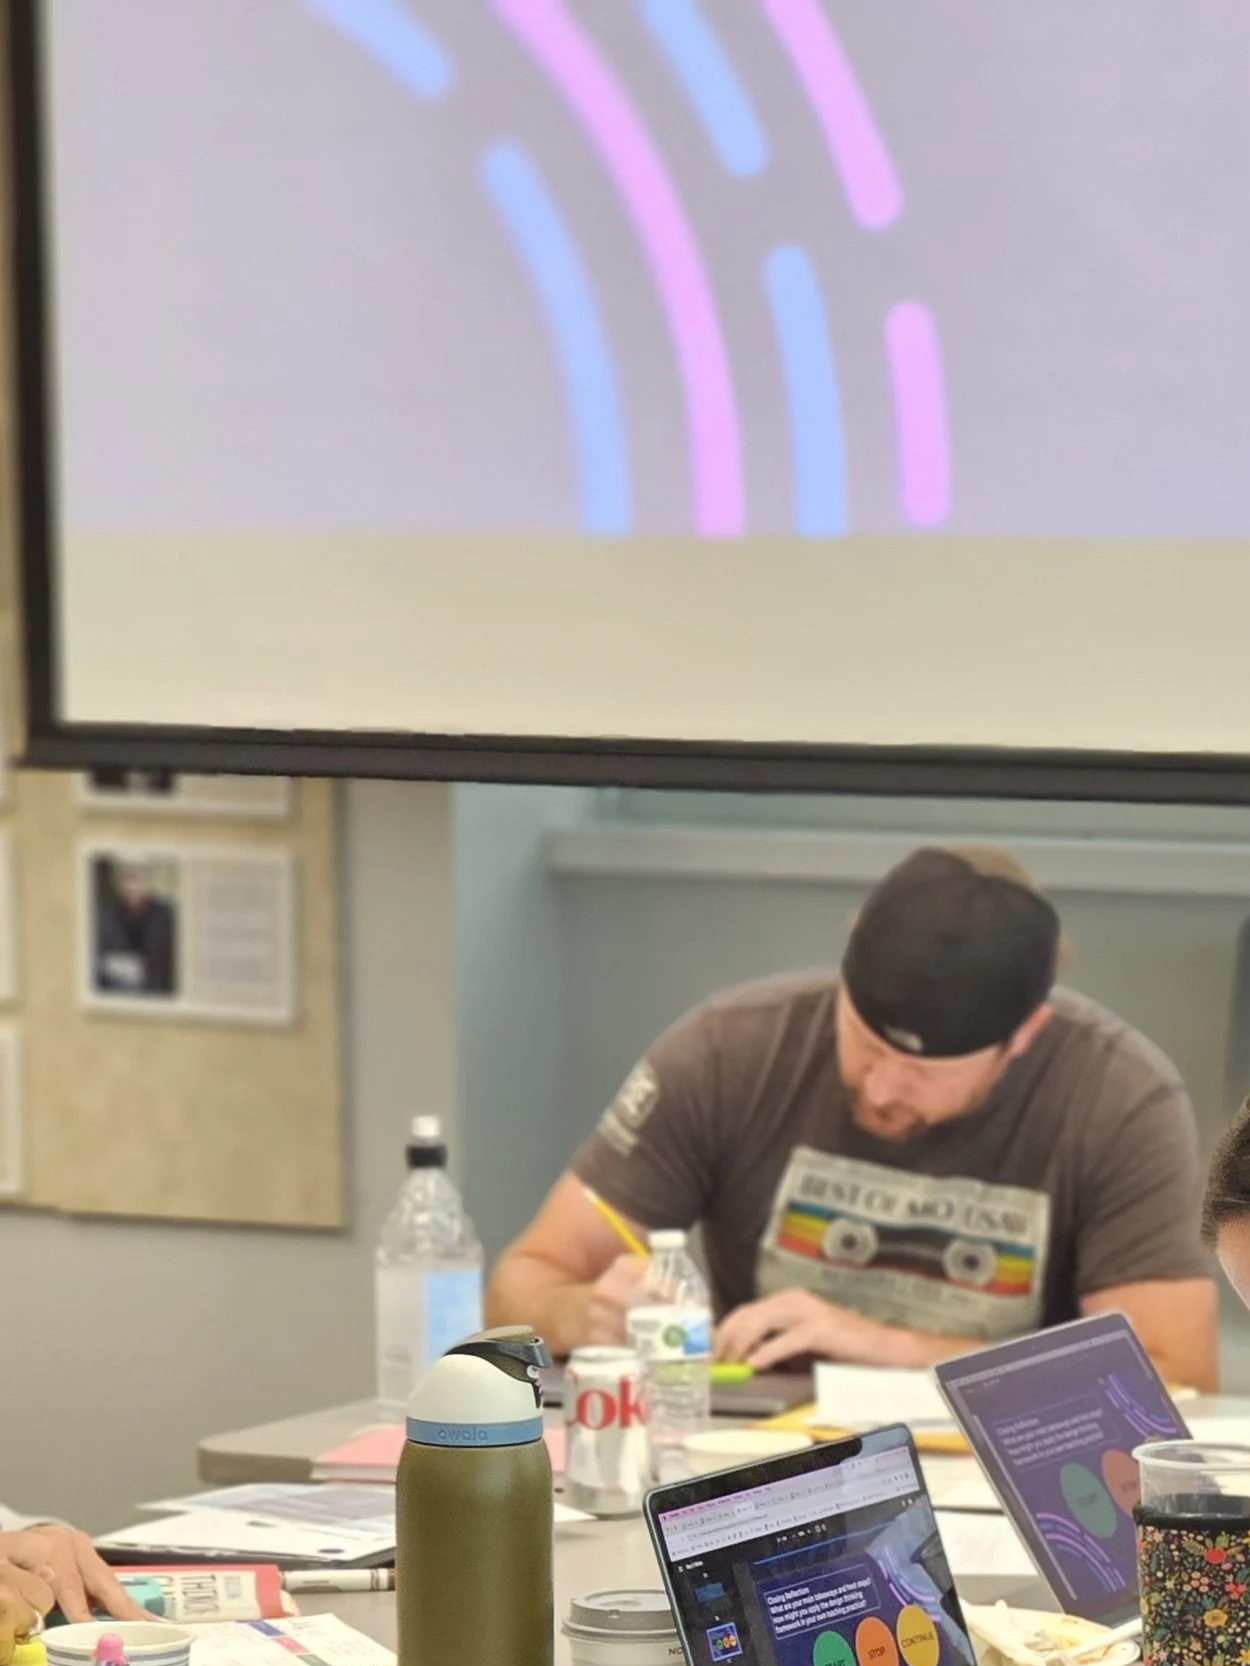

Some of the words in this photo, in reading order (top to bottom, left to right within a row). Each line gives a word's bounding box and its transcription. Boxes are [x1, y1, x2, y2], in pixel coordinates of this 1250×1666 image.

[437, 1425, 488, 1442] owala
[901, 1631, 934, 1649] CONTINUE
[868, 1646, 886, 1660] STOP
